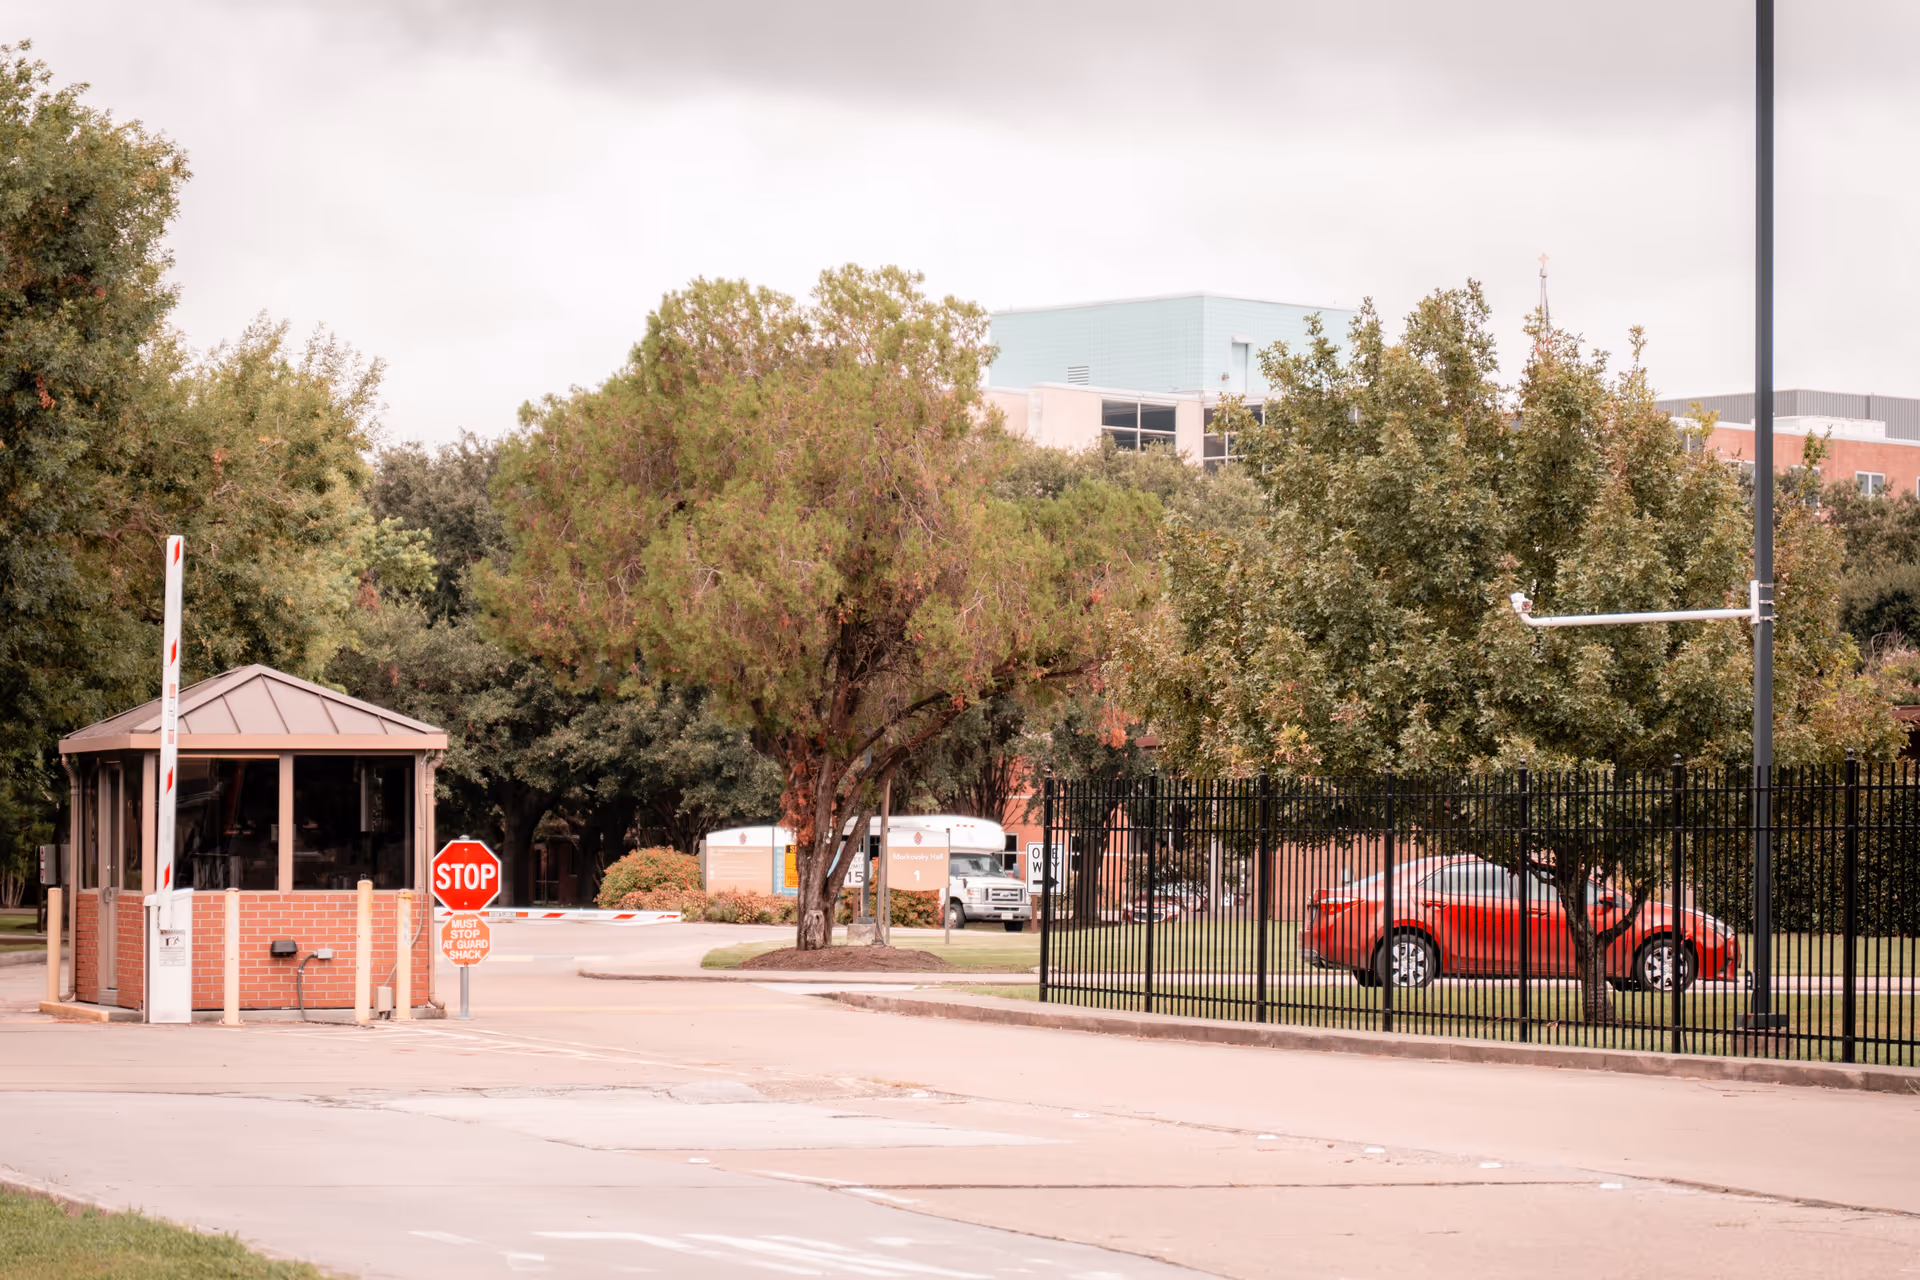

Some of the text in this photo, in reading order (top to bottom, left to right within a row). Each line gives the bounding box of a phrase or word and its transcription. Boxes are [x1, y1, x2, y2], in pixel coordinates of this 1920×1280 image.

[1032, 847, 1059, 859] OE
[1032, 861, 1060, 873] WY
[435, 863, 497, 890] STOP
[848, 871, 864, 883] 15
[913, 870, 921, 881] 1
[451, 919, 479, 928] MUST
[450, 929, 480, 938] STOP
[443, 939, 489, 949] AT GUARD
[449, 950, 482, 960] SHACK
